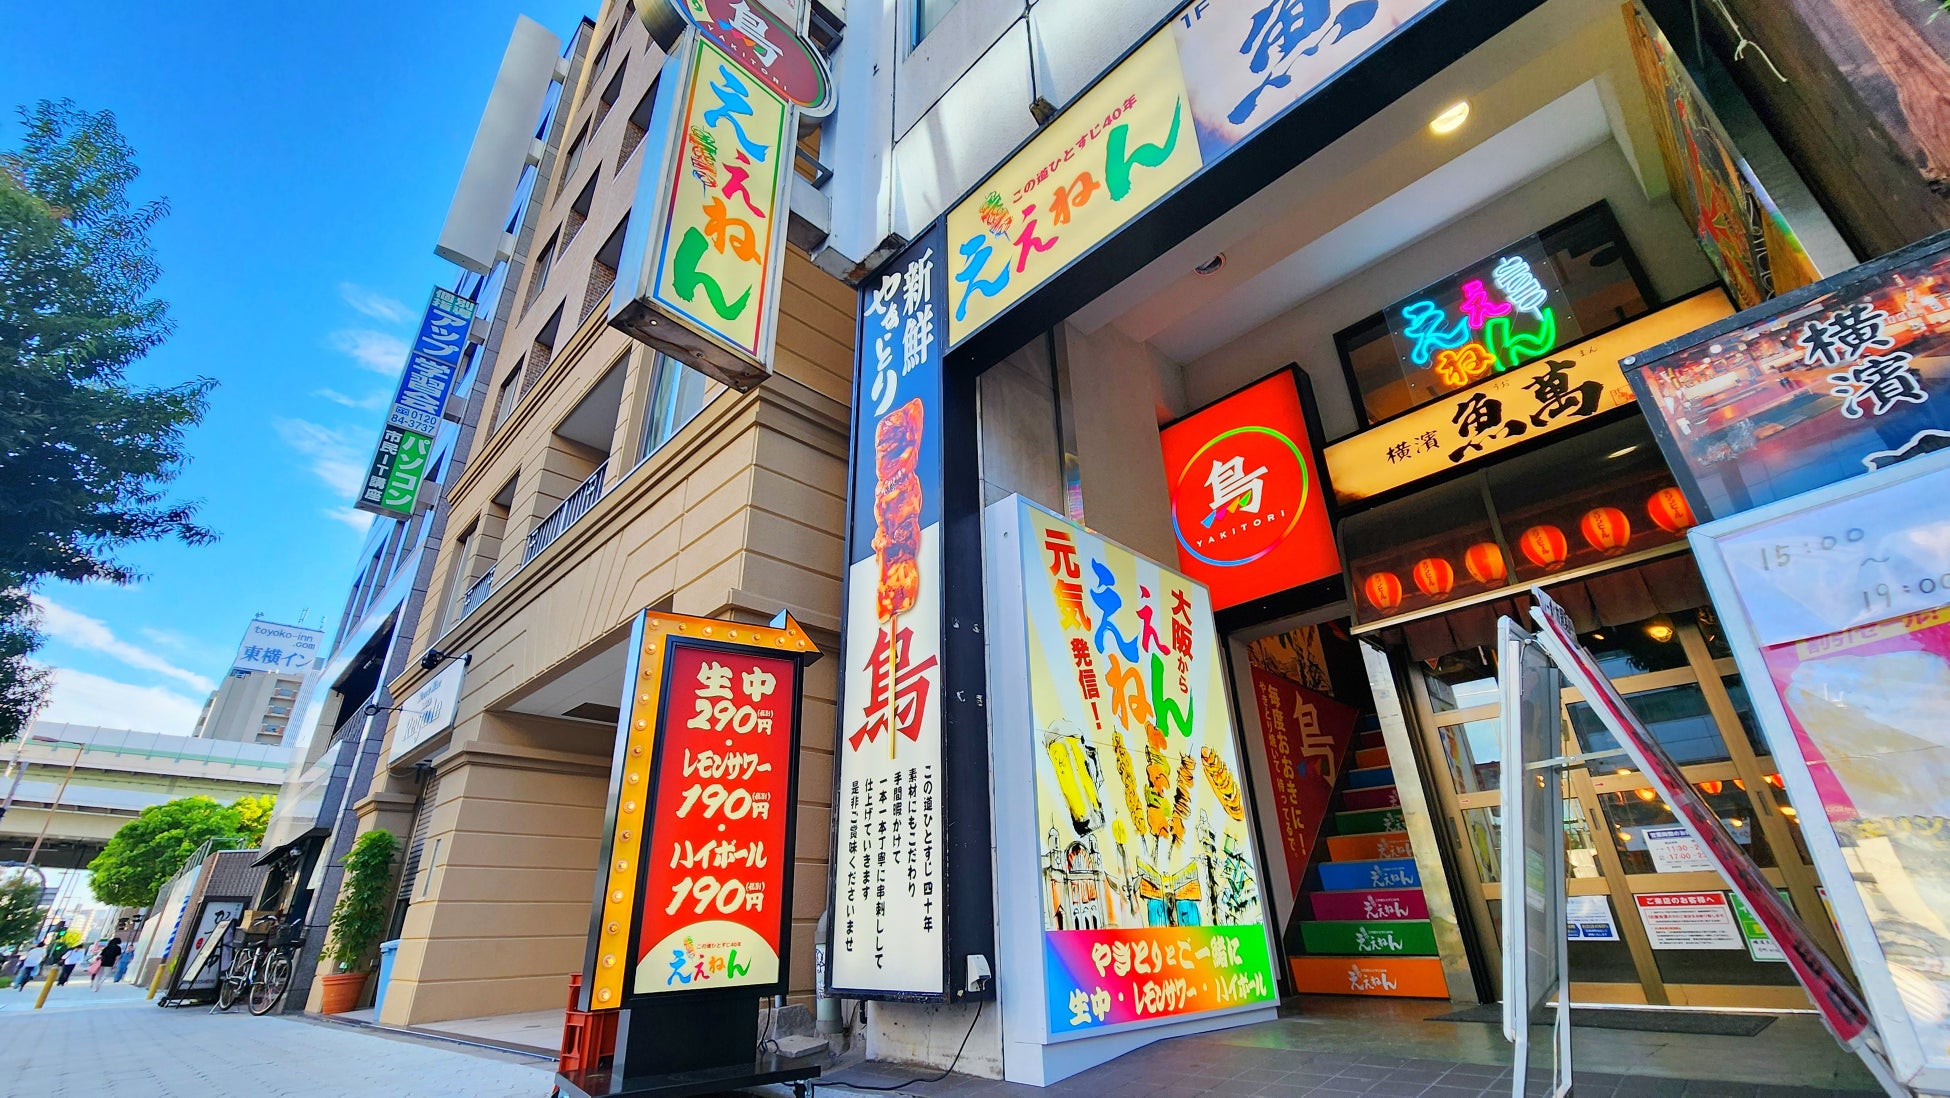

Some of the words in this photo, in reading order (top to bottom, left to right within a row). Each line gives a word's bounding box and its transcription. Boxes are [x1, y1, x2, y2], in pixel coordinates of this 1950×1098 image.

[707, 24, 787, 91] YAKITORI
[729, 0, 784, 68] 鳥
[1013, 94, 1137, 204] この道ひとすじ40年
[672, 64, 771, 321] ええねん
[955, 94, 1181, 322] ええねん
[864, 272, 902, 417] やきとり
[902, 247, 934, 377] 新鮮
[1401, 278, 1556, 386] ええねん
[1798, 303, 1929, 418] 横濱
[390, 414, 435, 434] 84-3737
[411, 410, 437, 425] 0120
[1386, 430, 1440, 464] 横濱
[1448, 360, 1604, 463] 魚萬
[385, 436, 430, 506] パソコン
[1201, 456, 1269, 529] 鳥
[1196, 510, 1285, 547] YAKITORI
[243, 645, 315, 667] 東横イン
[254, 625, 313, 642] toyoko-inn
[292, 641, 316, 650] .com
[1045, 528, 1102, 730] 元気発信!
[1171, 588, 1193, 694] 大阪から
[695, 661, 776, 702] 生中
[849, 626, 938, 752] 鳥
[687, 699, 773, 735] 290円
[683, 748, 772, 780] レモンサワー
[676, 784, 770, 820] 190円
[892, 771, 902, 864] 手間暇かけて
[908, 767, 917, 898] 素材にもこだわり
[669, 840, 767, 869] ハイボール
[845, 781, 860, 952] 是非ご賞味くださいませ
[862, 778, 873, 901] 仕上げていきます
[923, 765, 934, 933] この道ひとすじ四十年
[665, 876, 764, 916] 190円
[874, 778, 888, 970] 一本一本丁寧に串刺しして
[1370, 870, 1414, 887] ええねん
[1646, 897, 1715, 905] ご来店のお客様へ
[1355, 932, 1403, 951] ええねん
[1363, 901, 1409, 919] ええねん
[667, 949, 752, 985] ええねん
[1092, 935, 1243, 977] やきとりとご一緒に
[1348, 968, 1397, 991] ええねん
